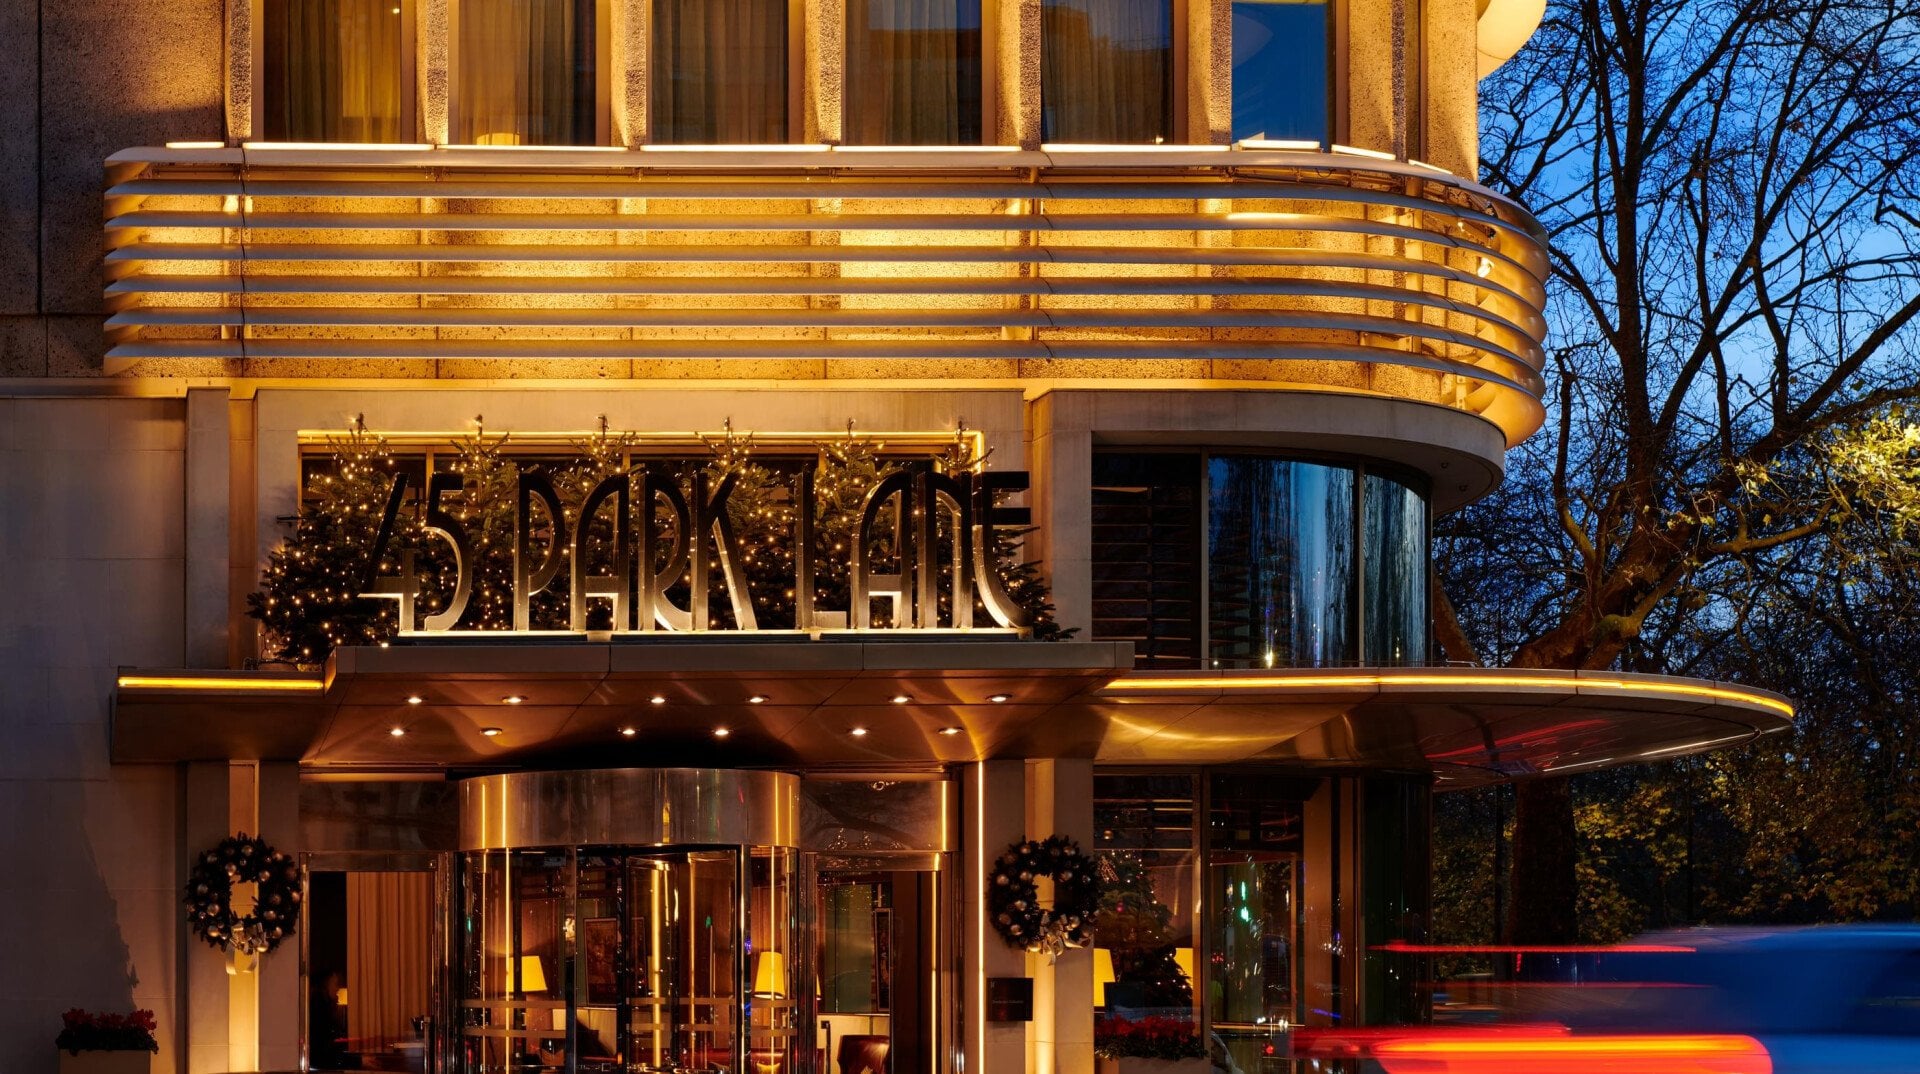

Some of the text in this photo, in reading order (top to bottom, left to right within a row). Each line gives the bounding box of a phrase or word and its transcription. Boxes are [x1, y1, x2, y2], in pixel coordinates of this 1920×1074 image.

[357, 471, 1032, 631] 45 PARK LANE
